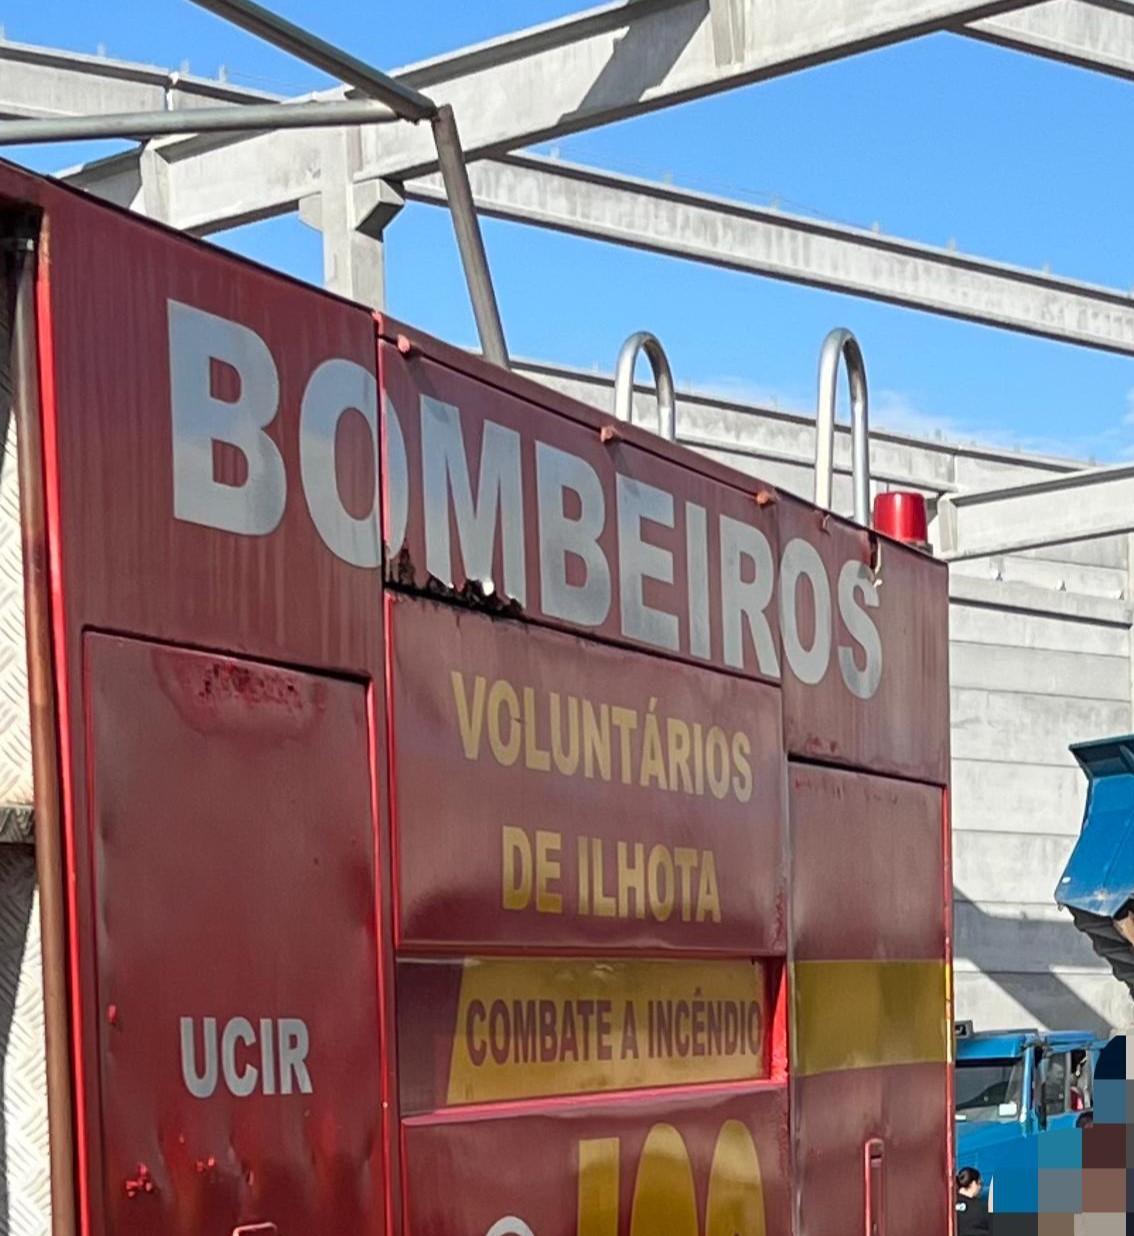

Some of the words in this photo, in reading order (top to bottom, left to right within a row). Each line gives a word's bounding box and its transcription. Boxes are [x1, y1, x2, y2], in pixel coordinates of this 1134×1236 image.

[168, 298, 882, 699] BOMBEIROS
[451, 670, 753, 802] VOLUNTÁRIOS
[502, 826, 563, 913] DE
[577, 835, 722, 923] ILHOTA
[180, 1015, 313, 1099] UCIR
[465, 997, 612, 1066] COMBATE
[620, 1000, 639, 1061] A
[647, 987, 762, 1057] INCÊNDIO
